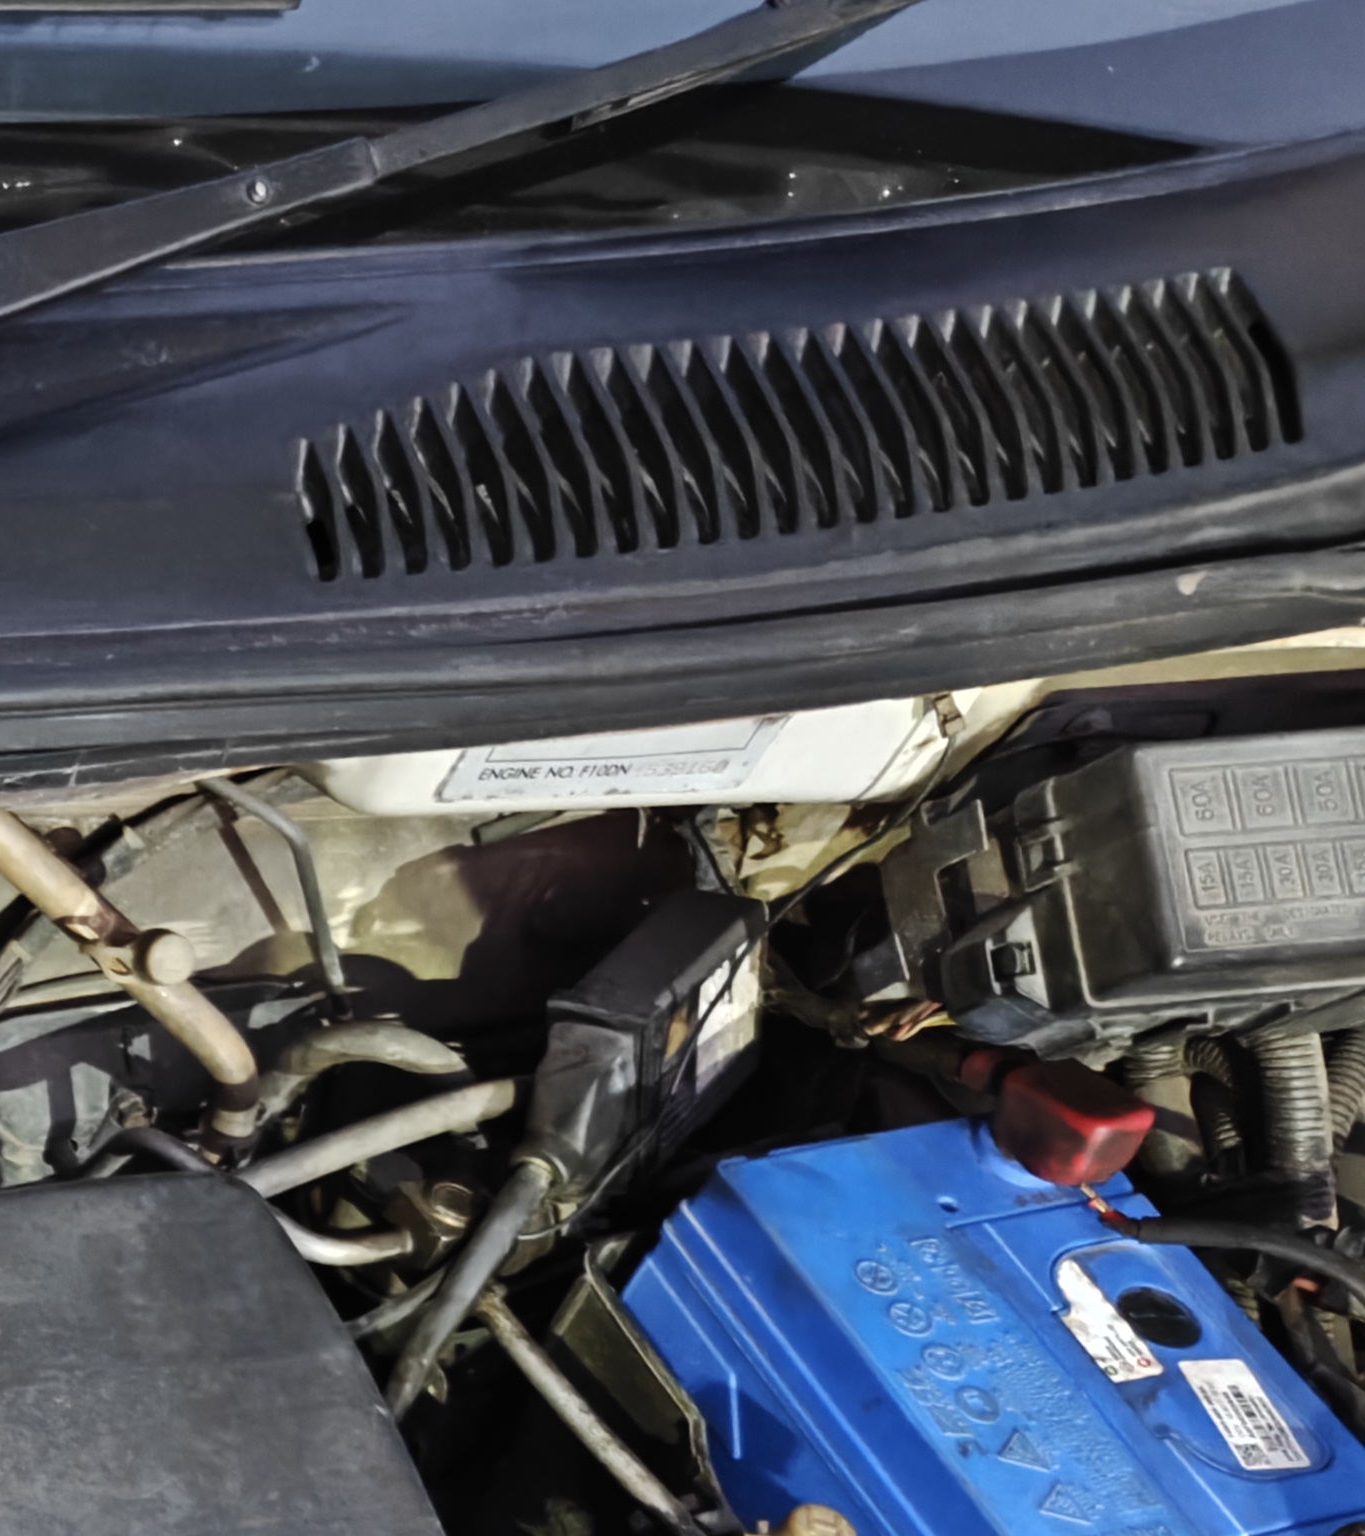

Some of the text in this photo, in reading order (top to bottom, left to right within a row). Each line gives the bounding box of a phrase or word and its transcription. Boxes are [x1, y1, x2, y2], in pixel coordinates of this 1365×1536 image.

[478, 766, 541, 781] ENGINE
[1314, 770, 1339, 813] 50A
[1190, 778, 1215, 822] 60A
[1251, 773, 1276, 818] 60A
[1197, 860, 1217, 893] 15A
